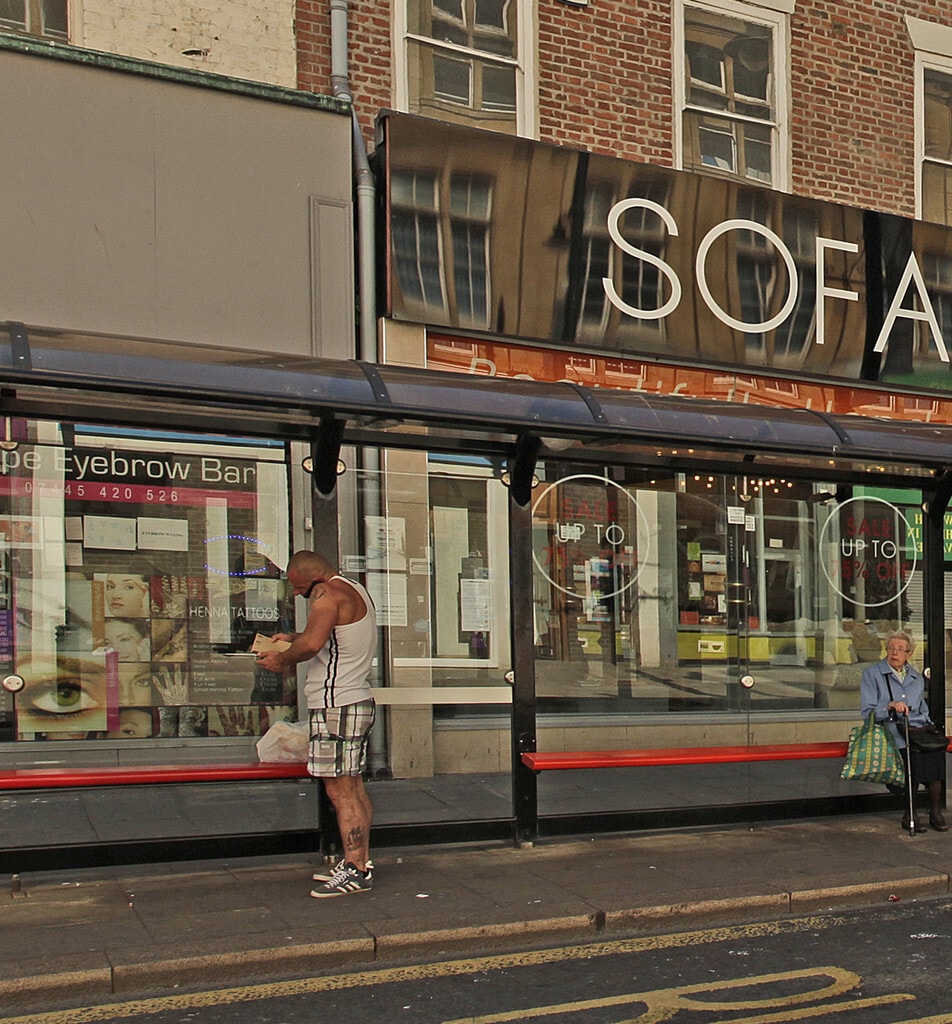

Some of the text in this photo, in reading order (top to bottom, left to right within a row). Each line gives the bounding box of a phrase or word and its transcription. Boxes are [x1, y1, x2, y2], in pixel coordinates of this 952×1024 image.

[602, 197, 950, 363] SOFA
[54, 447, 190, 480] Eyebrow
[201, 457, 256, 484] Bar
[562, 497, 618, 521] SALE
[555, 522, 625, 545] UP TO
[847, 517, 891, 537] SALE
[841, 538, 865, 557] UP
[872, 539, 897, 559] TO
[830, 559, 910, 582] 75% OFF
[189, 605, 280, 620] HENNA TATTOOS
